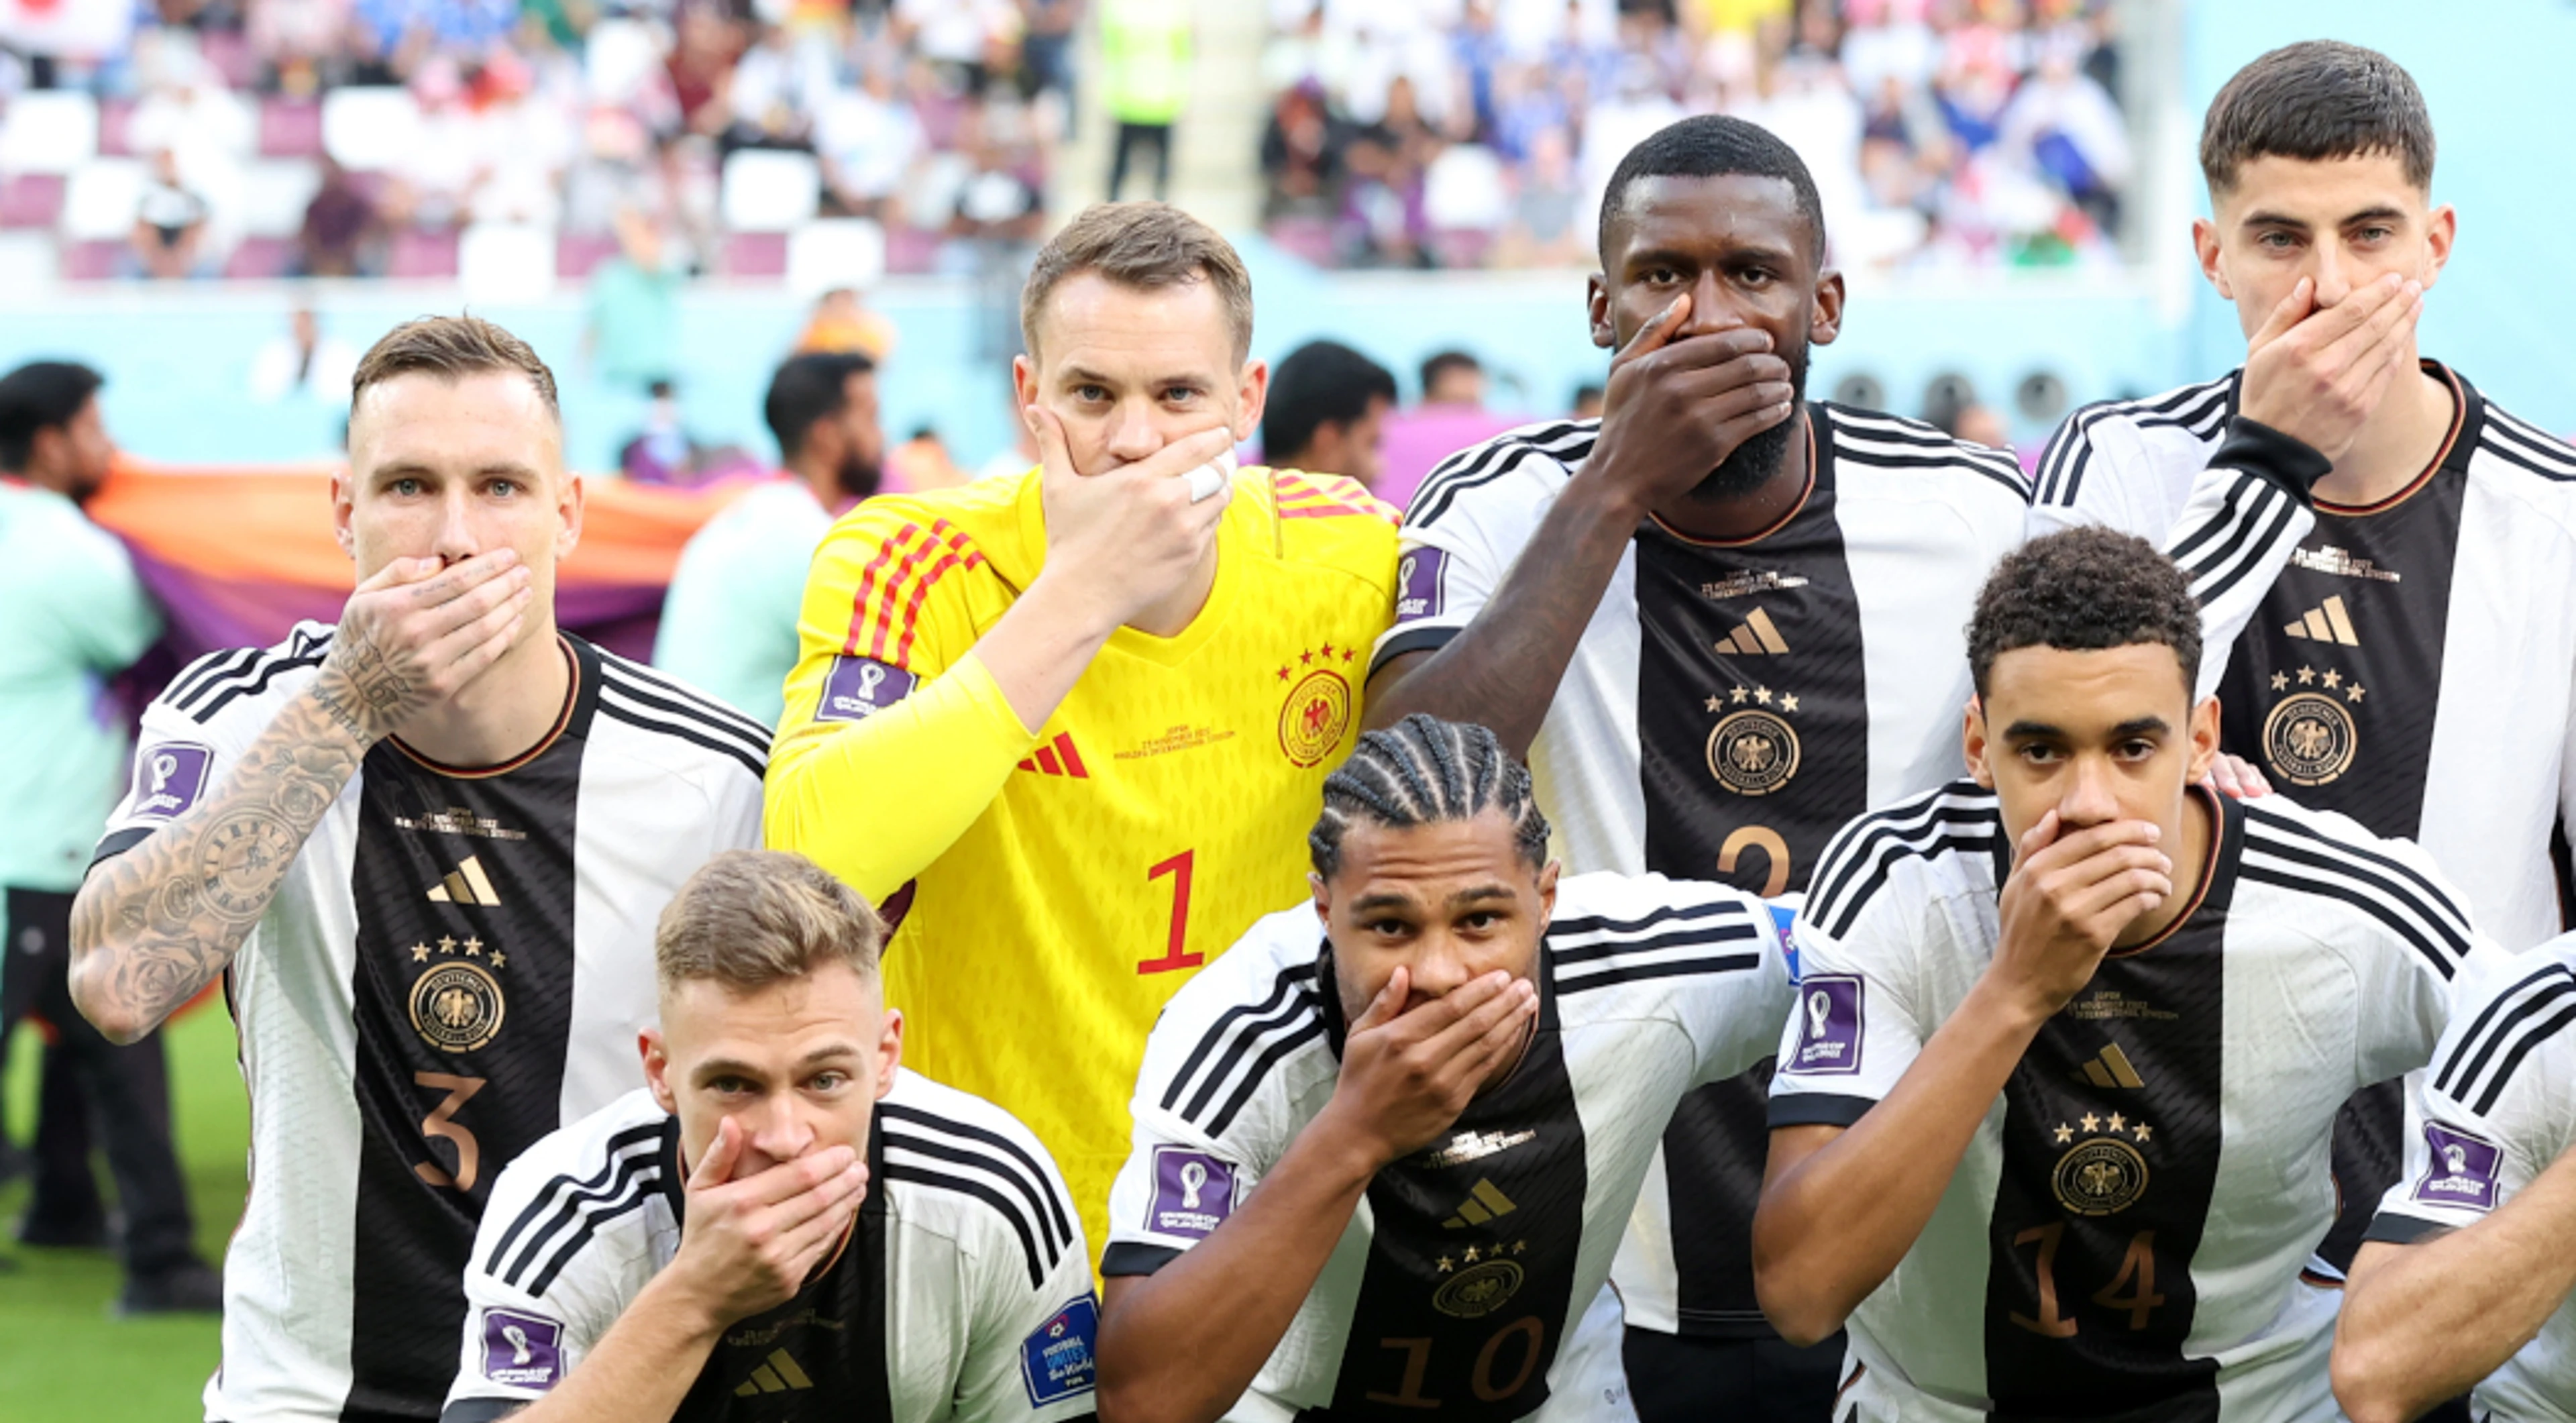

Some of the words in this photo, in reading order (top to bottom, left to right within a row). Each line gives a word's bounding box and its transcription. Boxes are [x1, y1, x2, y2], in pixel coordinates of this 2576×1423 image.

[1137, 847, 1205, 975] 1
[413, 1070, 488, 1192] 3
[2009, 1220, 2165, 1338] 14
[1365, 1315, 1544, 1408] 10
